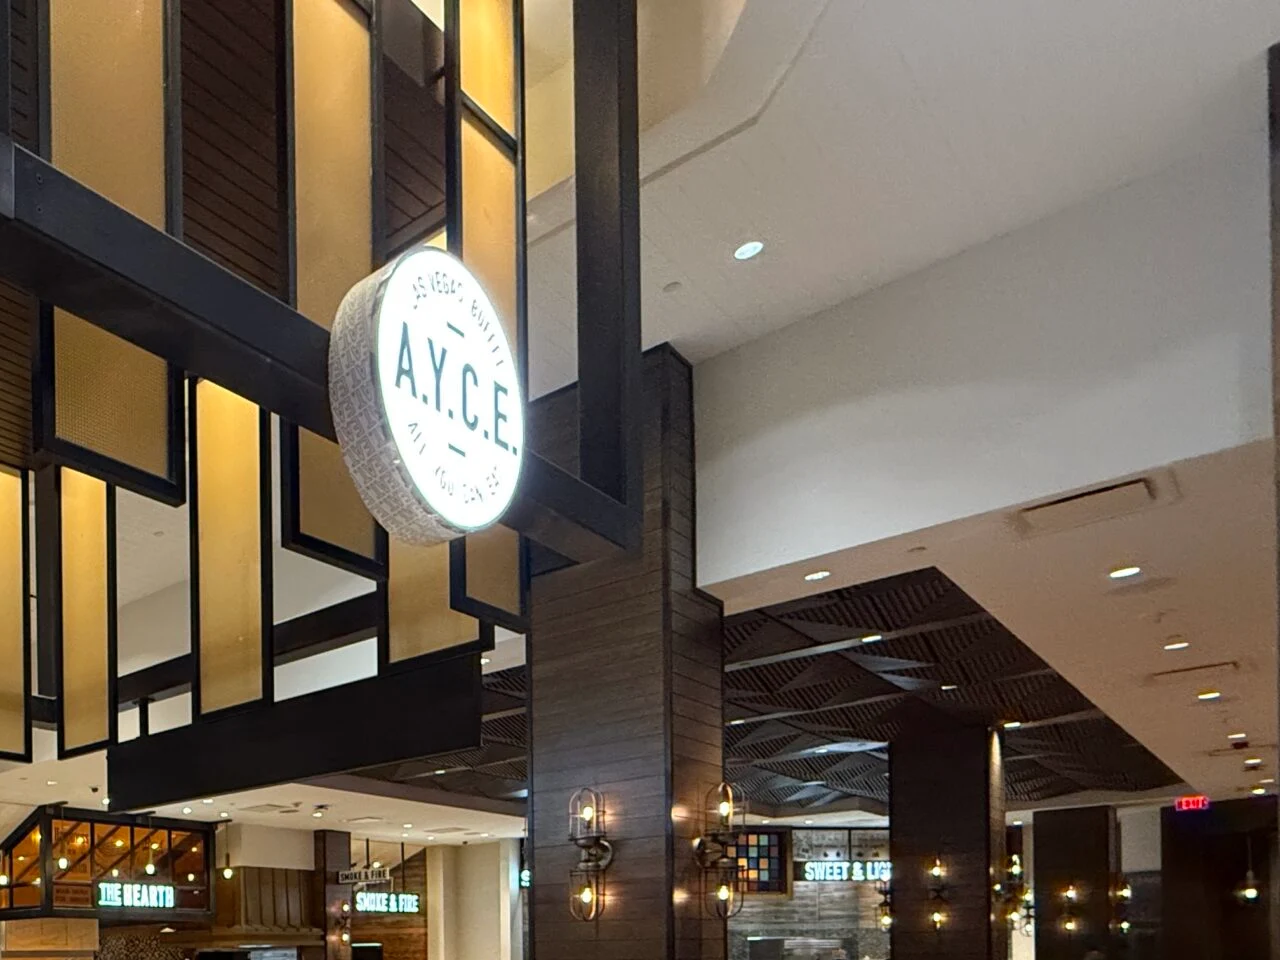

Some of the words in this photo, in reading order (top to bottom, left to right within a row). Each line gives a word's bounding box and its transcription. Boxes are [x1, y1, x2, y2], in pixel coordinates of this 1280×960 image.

[804, 861, 850, 880] SWEET
[851, 861, 865, 880] &
[98, 882, 122, 902] THE
[123, 883, 175, 908] HEARTH
[356, 891, 388, 912] SMOKE
[388, 893, 398, 912] &
[398, 893, 419, 912] FIRE
